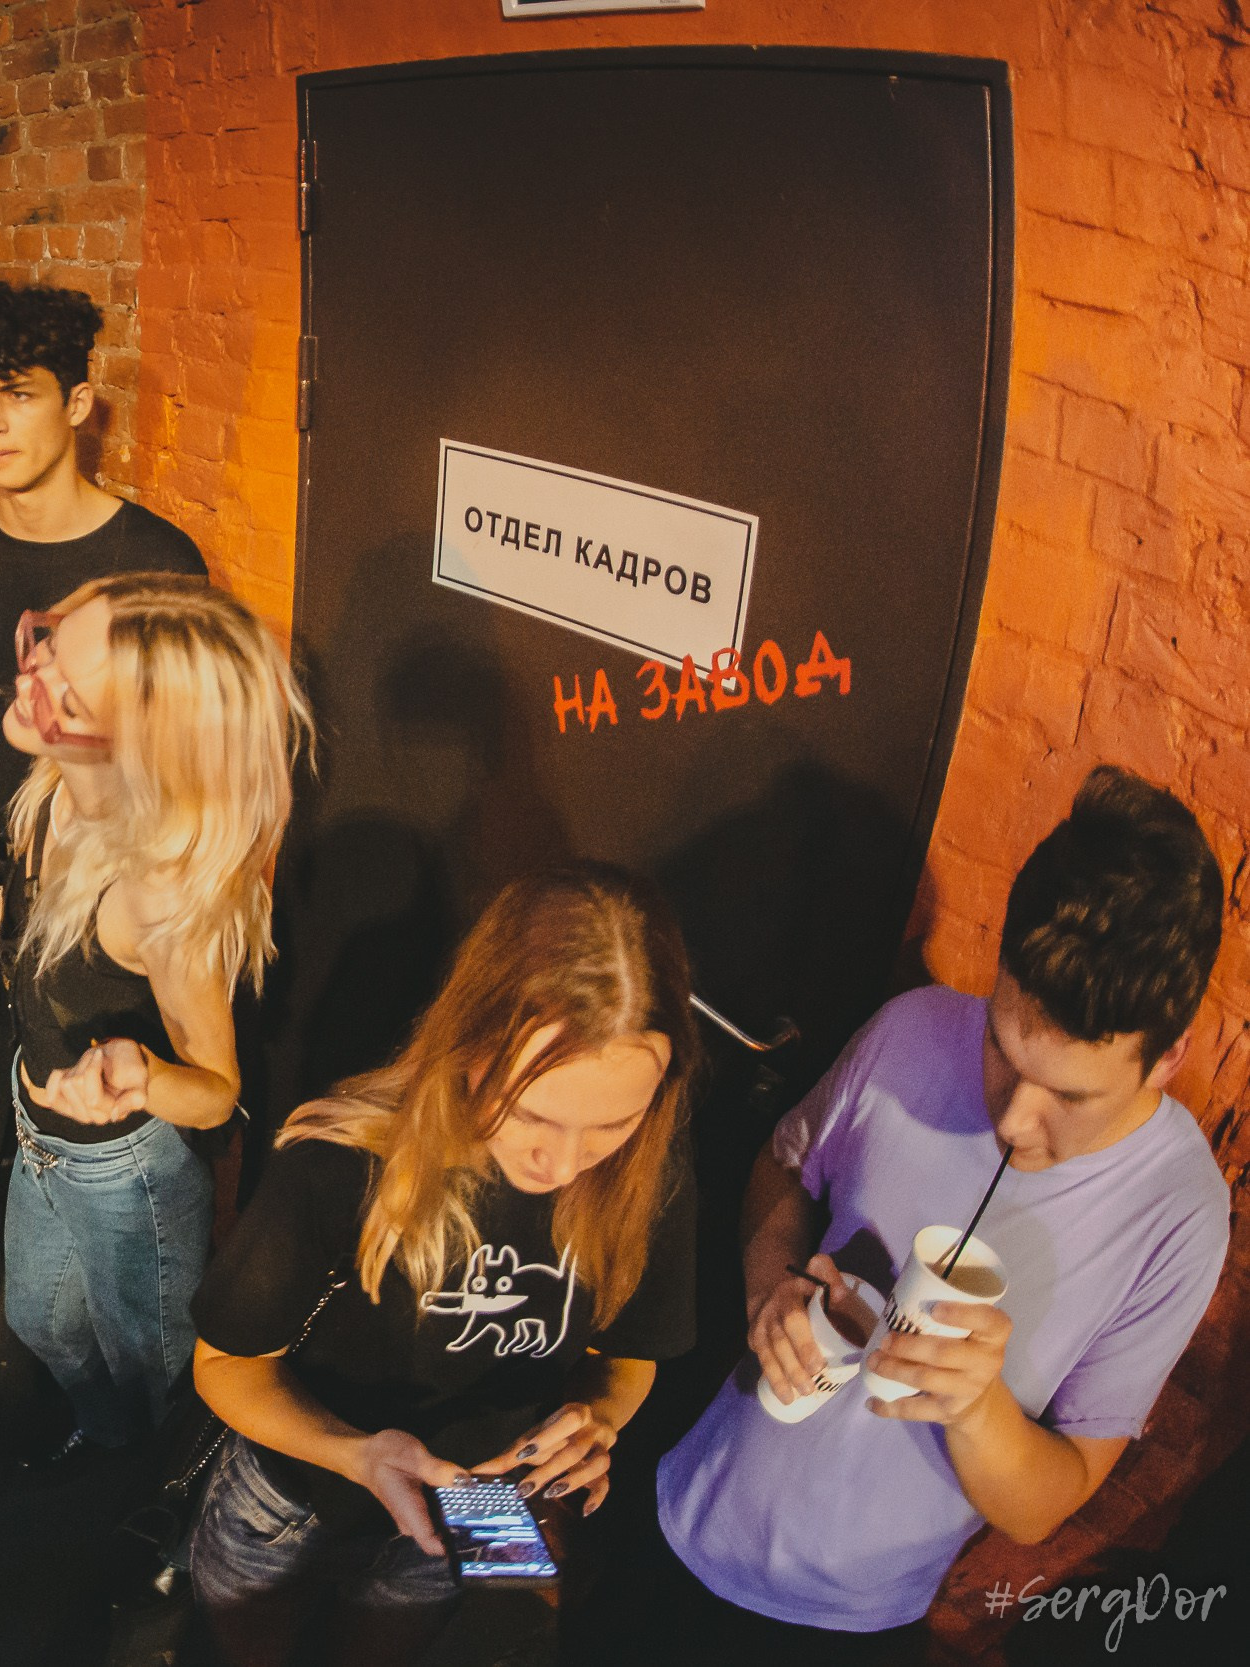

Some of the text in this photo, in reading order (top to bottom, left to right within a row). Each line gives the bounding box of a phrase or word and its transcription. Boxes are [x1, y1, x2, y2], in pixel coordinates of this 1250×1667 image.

[464, 506, 712, 604] ОТДЕЛ КАДРОВ
[553, 630, 852, 734] НА ЗАВОД
